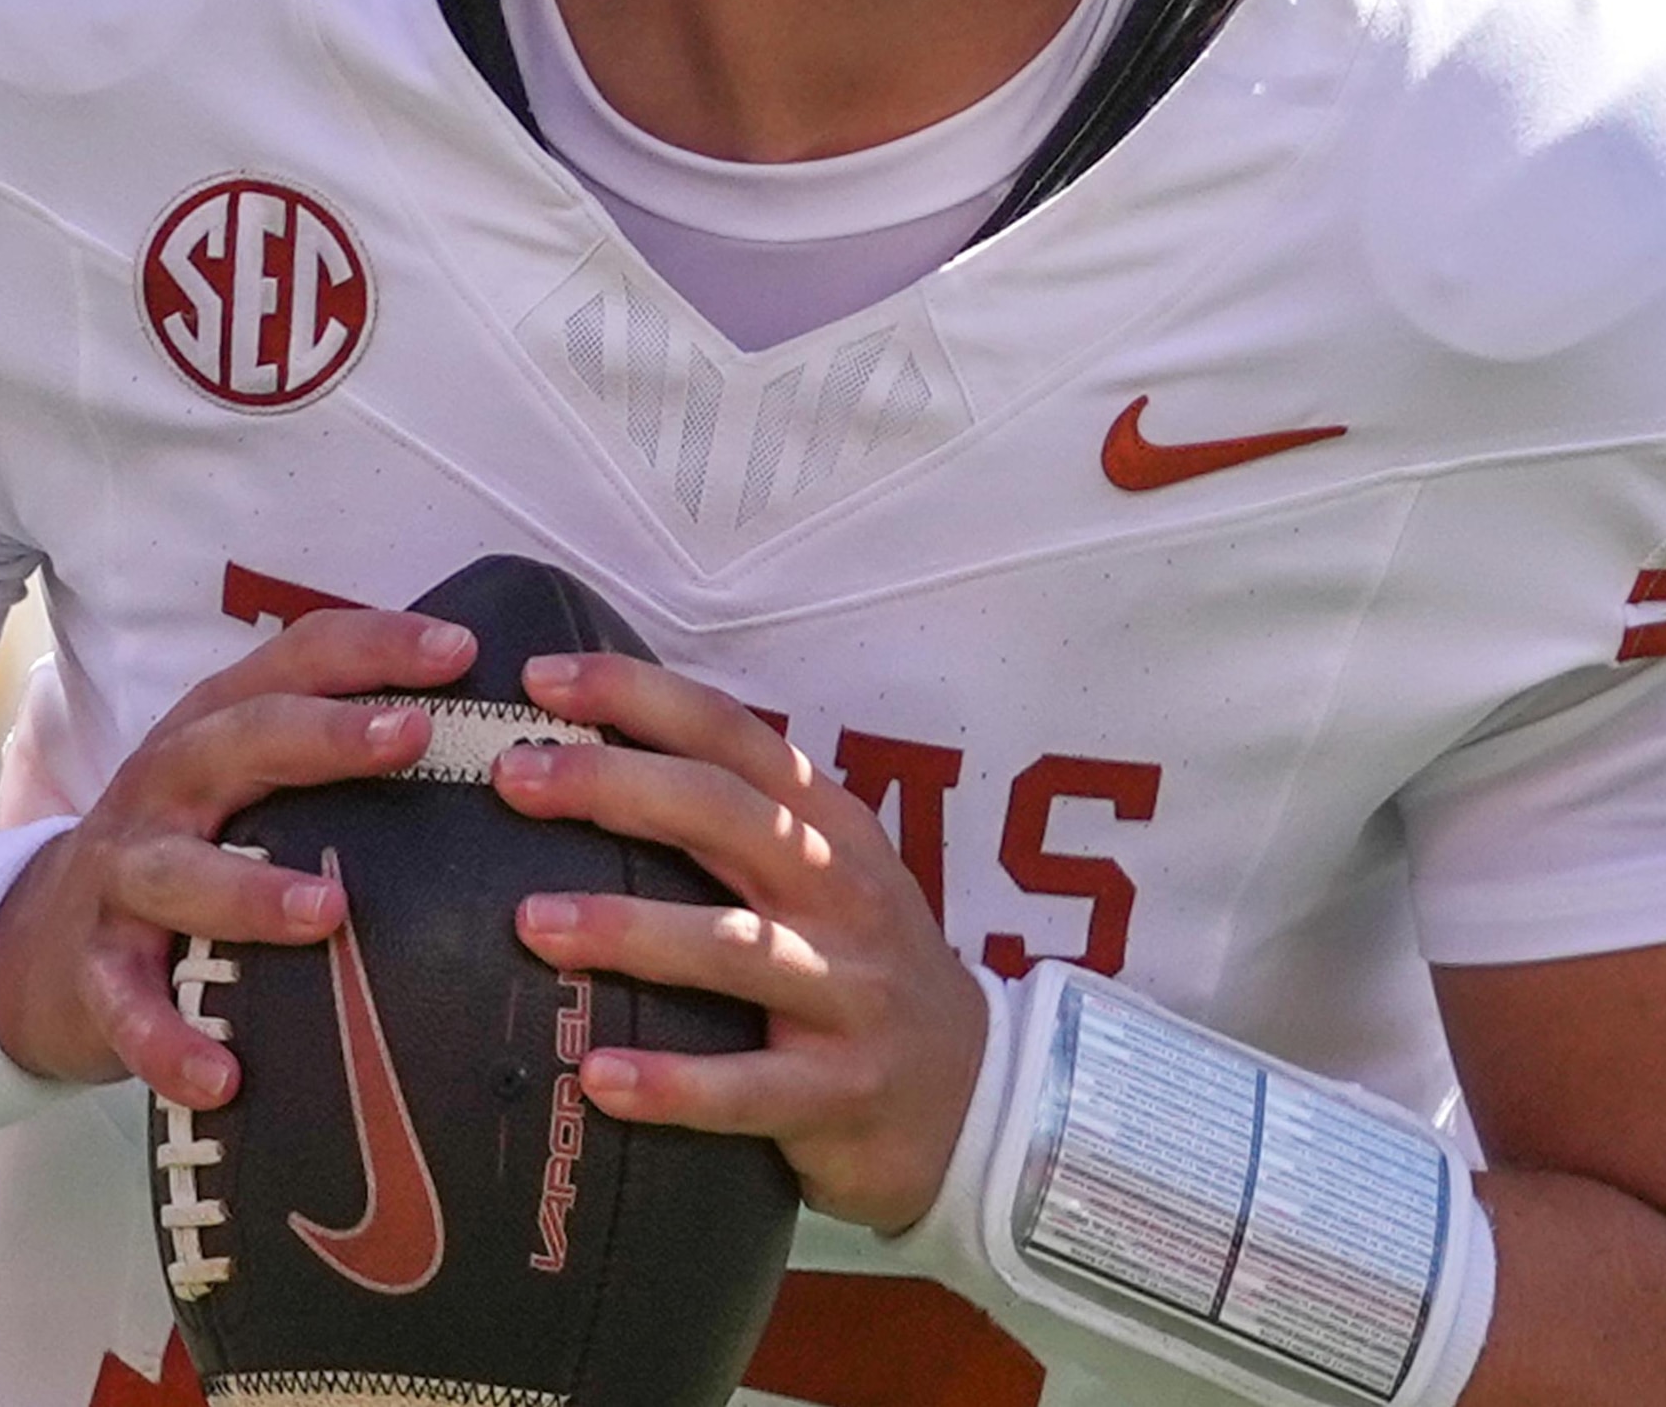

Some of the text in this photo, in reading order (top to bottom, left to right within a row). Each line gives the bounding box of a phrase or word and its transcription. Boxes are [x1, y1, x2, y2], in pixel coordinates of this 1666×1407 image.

[158, 191, 354, 395] SEC
[529, 970, 592, 1273] VAPOR ELI
